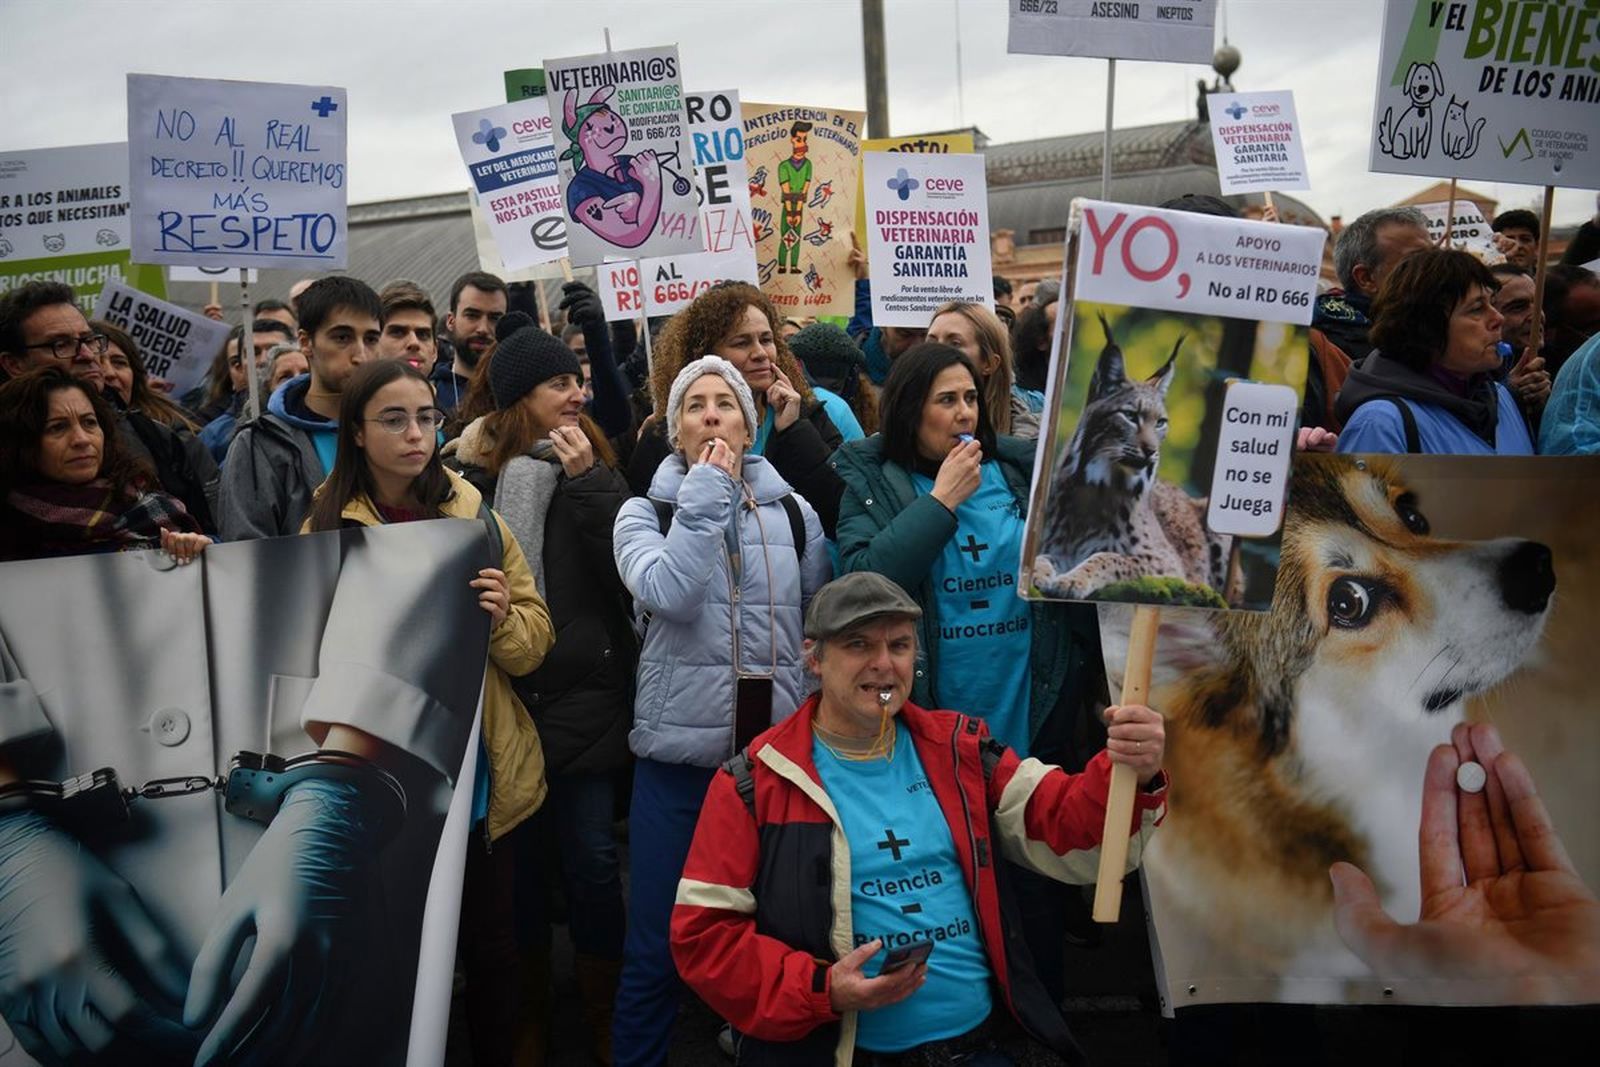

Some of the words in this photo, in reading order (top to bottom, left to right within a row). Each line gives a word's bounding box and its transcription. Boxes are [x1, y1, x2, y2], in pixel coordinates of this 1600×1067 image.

[1090, 2, 1139, 19] ASESINO
[1157, 6, 1193, 21] INEPTOS
[1429, 2, 1444, 28] Y
[1445, 3, 1467, 31] EL
[549, 57, 677, 92] VETERINARI@S
[1478, 65, 1508, 94] DE
[1512, 69, 1555, 99] LOS
[617, 84, 680, 103] SANITARI@S
[619, 104, 631, 117] DE
[633, 98, 683, 116] CONFIANZA
[1252, 104, 1280, 114] ceve
[513, 116, 552, 135] ceve
[628, 114, 680, 127] MODIFICACIÓN
[744, 108, 828, 132] INTERFERENCIA
[832, 115, 845, 126] EN
[846, 124, 859, 138] EL
[1219, 121, 1293, 136] DISPENSACIÓN
[156, 109, 195, 141] NO
[215, 117, 244, 147] AL
[266, 119, 320, 152] REAL
[631, 129, 644, 142] RD
[646, 125, 681, 140] 666/23
[1223, 132, 1291, 145] VETERINARIA
[693, 127, 744, 165] RIO
[1234, 141, 1286, 154] GARANTÍA
[1234, 153, 1288, 165] SANITARIA
[251, 155, 344, 188] QUEREMOS
[477, 167, 493, 177] LEY
[493, 162, 510, 174] DEL
[499, 161, 556, 182] VETERINARIO
[926, 178, 964, 191] ceve
[15, 194, 24, 208] A
[28, 191, 53, 206] LOS
[57, 185, 121, 203] ANIMALES
[213, 187, 269, 213] MÁS
[490, 195, 516, 213] ESTA
[27, 210, 53, 225] QUE
[495, 210, 518, 224] NOS
[519, 206, 533, 217] LA
[534, 197, 563, 215] TRAG
[876, 209, 979, 226] DISPENSACIÓN
[157, 211, 337, 254] RESPETO
[661, 211, 697, 240] YA!
[881, 228, 976, 243] VETERINARIA
[1236, 235, 1281, 252] APOYO
[895, 243, 967, 260] GARANTÍA
[1083, 208, 1191, 299] YO,
[893, 262, 968, 278] SANITARIA
[1196, 252, 1205, 263] A
[1208, 254, 1231, 267] LOS
[1235, 257, 1317, 276] VETERINARIOS
[611, 267, 639, 289] NO
[656, 262, 683, 282] AL
[880, 293, 927, 302] medicamentos
[975, 294, 985, 302] los
[901, 285, 912, 293] Por
[913, 285, 920, 293] la
[939, 285, 954, 293] libre
[954, 285, 963, 293] de
[1208, 282, 1231, 298] No
[1236, 285, 1250, 301] al
[1256, 288, 1277, 303] RD
[1282, 290, 1309, 307] 666
[109, 291, 134, 316] LA
[134, 303, 191, 339] SALUD
[885, 303, 909, 312] Centros
[130, 324, 186, 360] PUEDE
[1227, 407, 1260, 426] Con
[1266, 411, 1289, 427] mi
[1231, 438, 1280, 456] salud
[1226, 469, 1248, 482] no
[1252, 470, 1272, 484] se
[1220, 494, 1272, 516] Juega
[944, 571, 1014, 593] Ciencia
[938, 616, 1028, 640] urocracia
[906, 781, 929, 794] VETE
[860, 869, 943, 897] Ciencia
